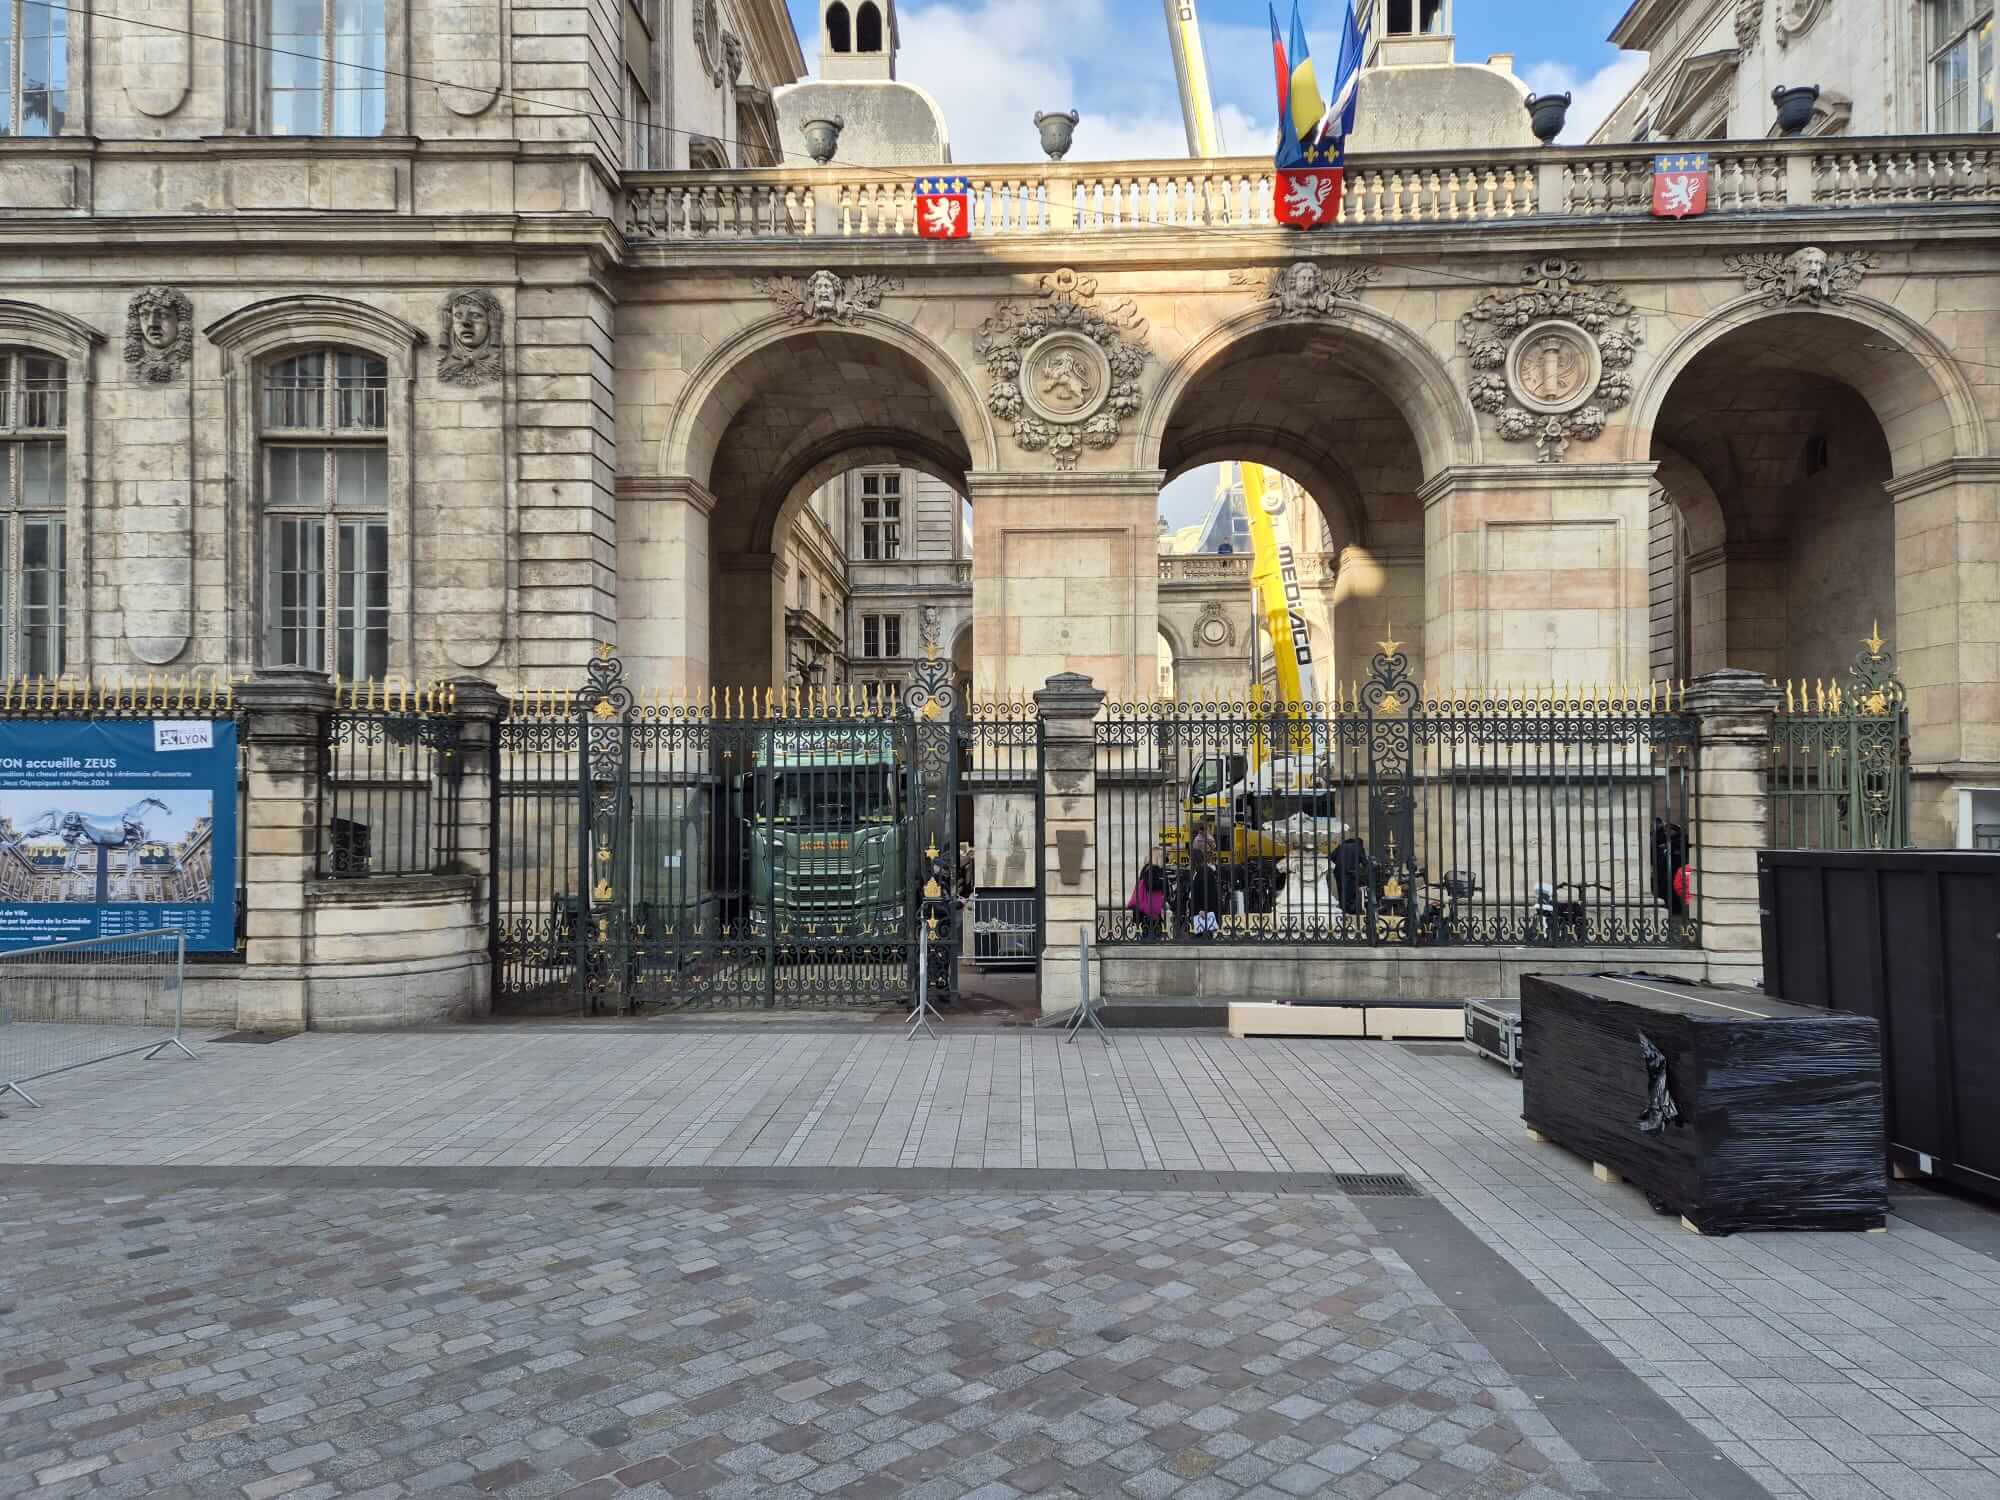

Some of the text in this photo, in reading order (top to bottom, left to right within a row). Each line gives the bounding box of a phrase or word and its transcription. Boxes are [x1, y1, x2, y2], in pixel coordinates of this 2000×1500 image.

[179, 734, 208, 745] LYON
[25, 757, 81, 769] accueille
[84, 758, 117, 769] ZEUS
[91, 779, 111, 787] 2024
